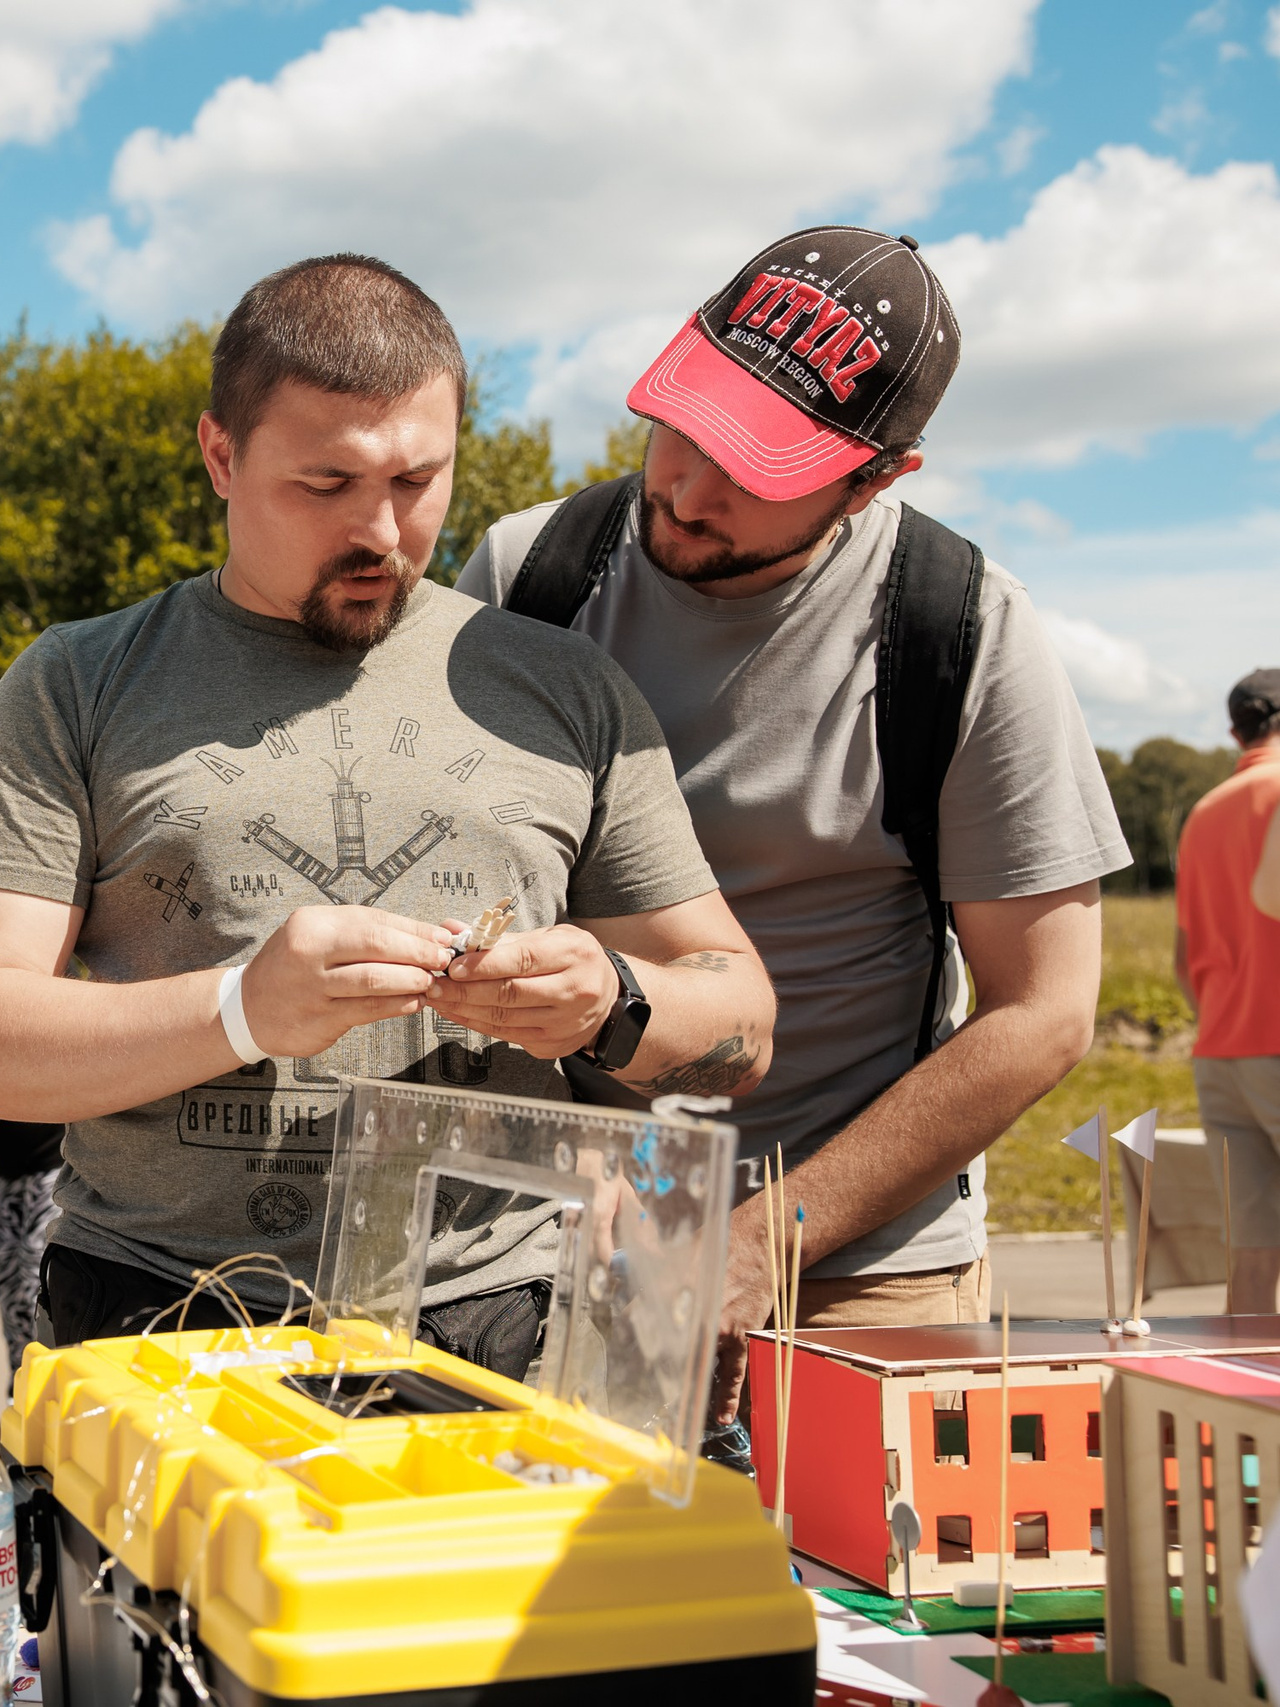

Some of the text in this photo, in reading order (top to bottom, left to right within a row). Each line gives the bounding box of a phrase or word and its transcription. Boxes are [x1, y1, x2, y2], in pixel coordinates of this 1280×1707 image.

[727, 272, 882, 404] VITYAZ
[767, 264, 890, 352] HOCKEY CLUB
[726, 327, 824, 400] MOSCOW REGION
[154, 708, 535, 831] KAMERAD
[187, 1101, 319, 1137] ВРЕДНЫЕ
[246, 1157, 326, 1175] INTERNATIONAL
[277, 1185, 286, 1194] OF
